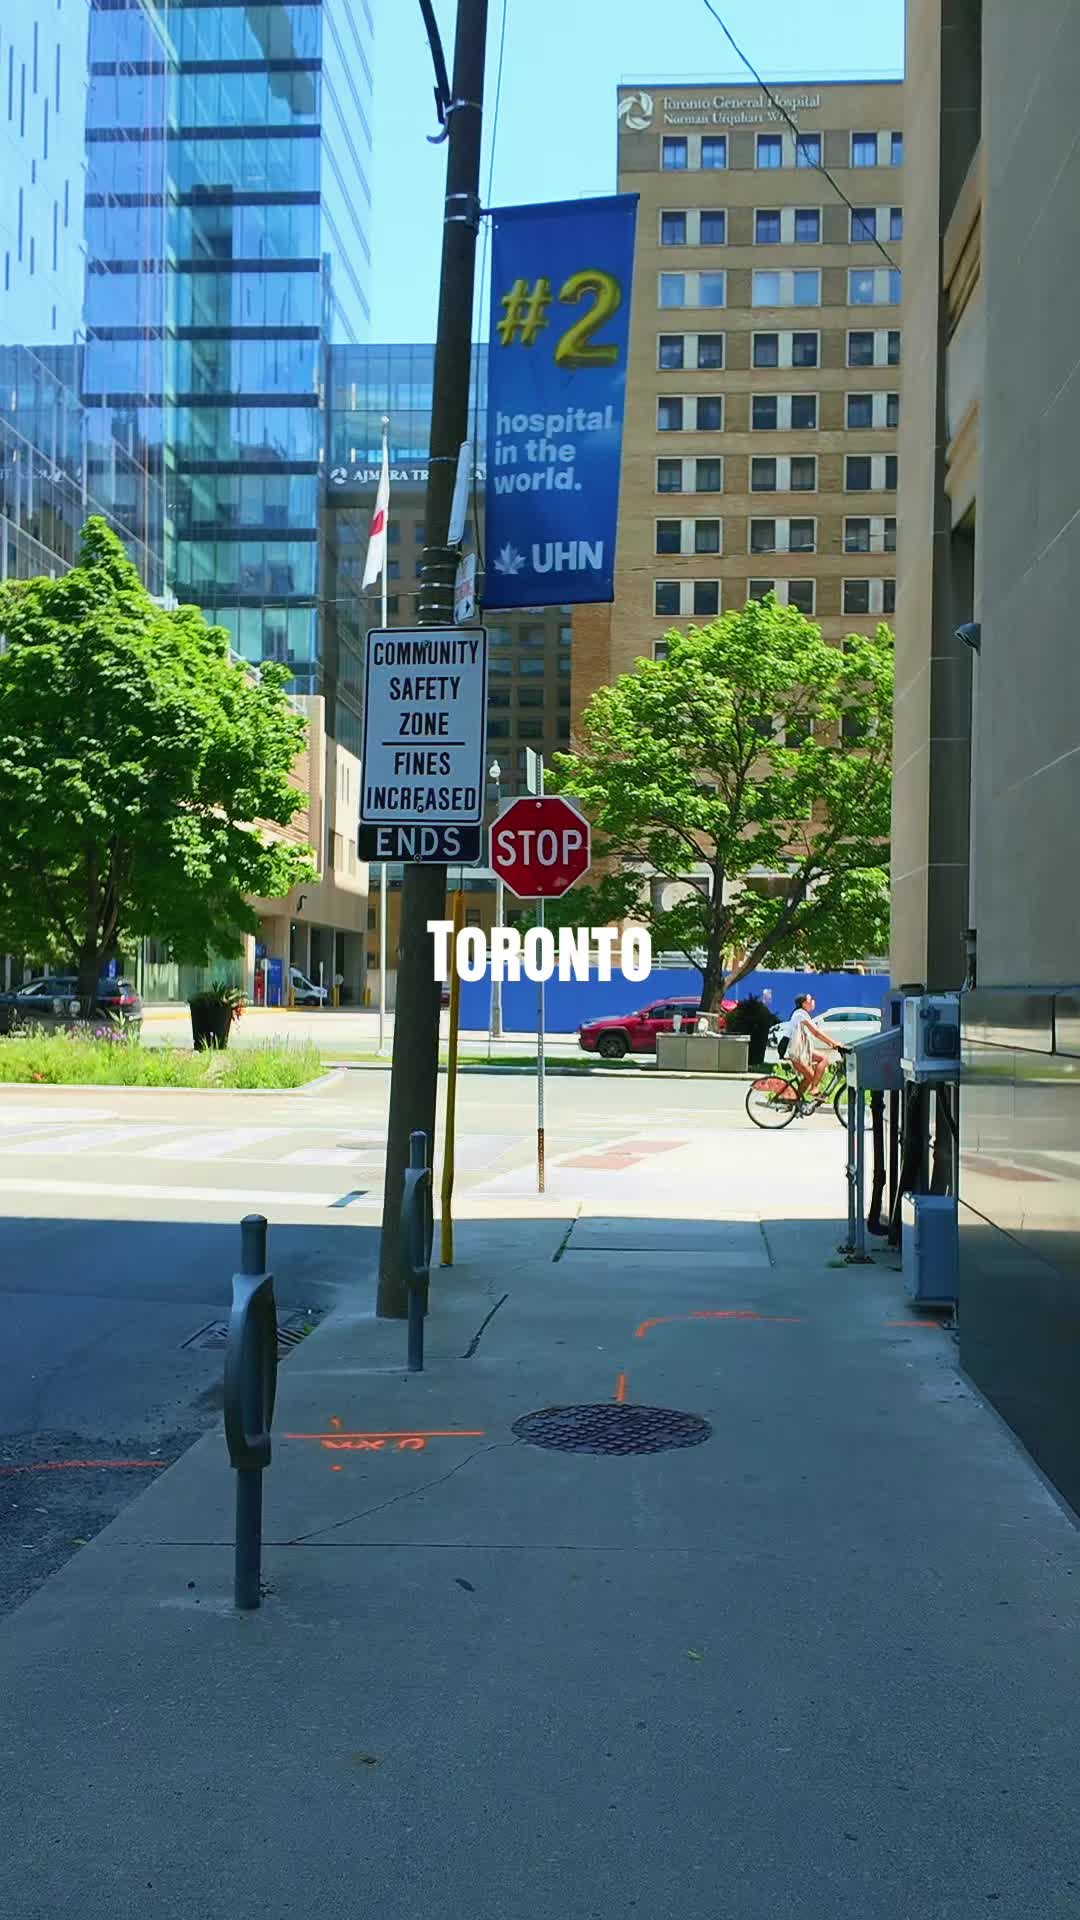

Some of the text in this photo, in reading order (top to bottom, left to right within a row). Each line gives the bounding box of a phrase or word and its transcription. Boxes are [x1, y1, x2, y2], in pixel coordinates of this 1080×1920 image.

[663, 94, 820, 111] Toronto General Hospital
[663, 112, 709, 124] Norman
[713, 111, 763, 126] Urquhart
[497, 269, 622, 369] #2
[496, 405, 613, 440] hospital
[495, 437, 576, 465] in the
[353, 469, 408, 483] AJMRA
[494, 468, 582, 495] world.
[531, 541, 604, 574] UHN
[373, 640, 479, 666] COMMUNITY
[389, 676, 461, 700] SAFETY
[399, 712, 449, 735] ZONE
[394, 752, 451, 775] FINES
[366, 787, 477, 811] INCREASED
[376, 827, 461, 857] ENDS
[496, 829, 583, 866] STOP
